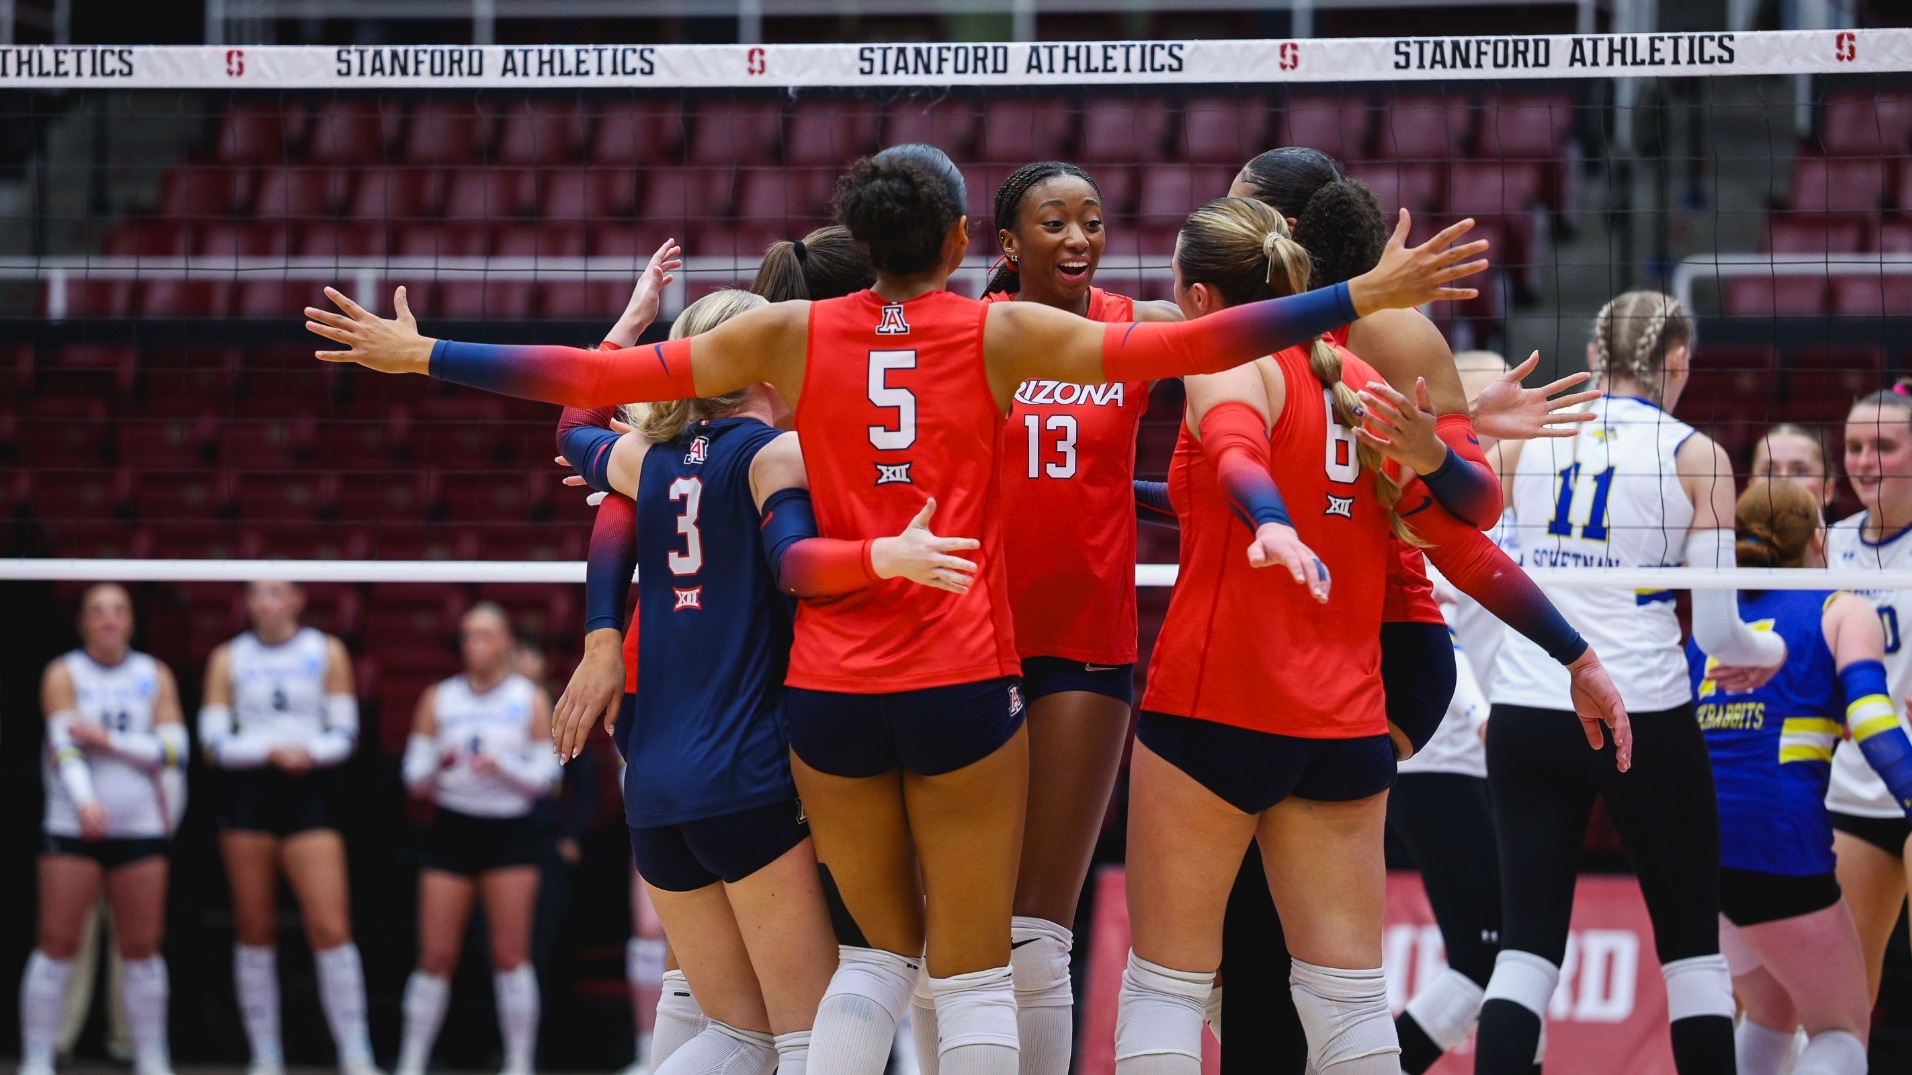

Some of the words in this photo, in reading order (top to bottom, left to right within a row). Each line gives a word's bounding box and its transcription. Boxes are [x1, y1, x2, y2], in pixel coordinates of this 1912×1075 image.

[336, 48, 484, 76] STANFORD
[501, 48, 655, 76] ATHLETICS
[859, 45, 1008, 75] STANFORD
[1026, 43, 1184, 74] ATHLETICS
[1394, 37, 1551, 70] STANFORD
[1568, 34, 1736, 67] ATHLETICS
[876, 305, 910, 335] A
[867, 350, 917, 451] 5
[683, 436, 709, 465] A
[1024, 413, 1078, 479] 13
[874, 461, 912, 486] XII
[1324, 493, 1355, 519] XII
[1547, 460, 1616, 543] 11
[667, 475, 703, 577] 3
[672, 585, 703, 612] XII
